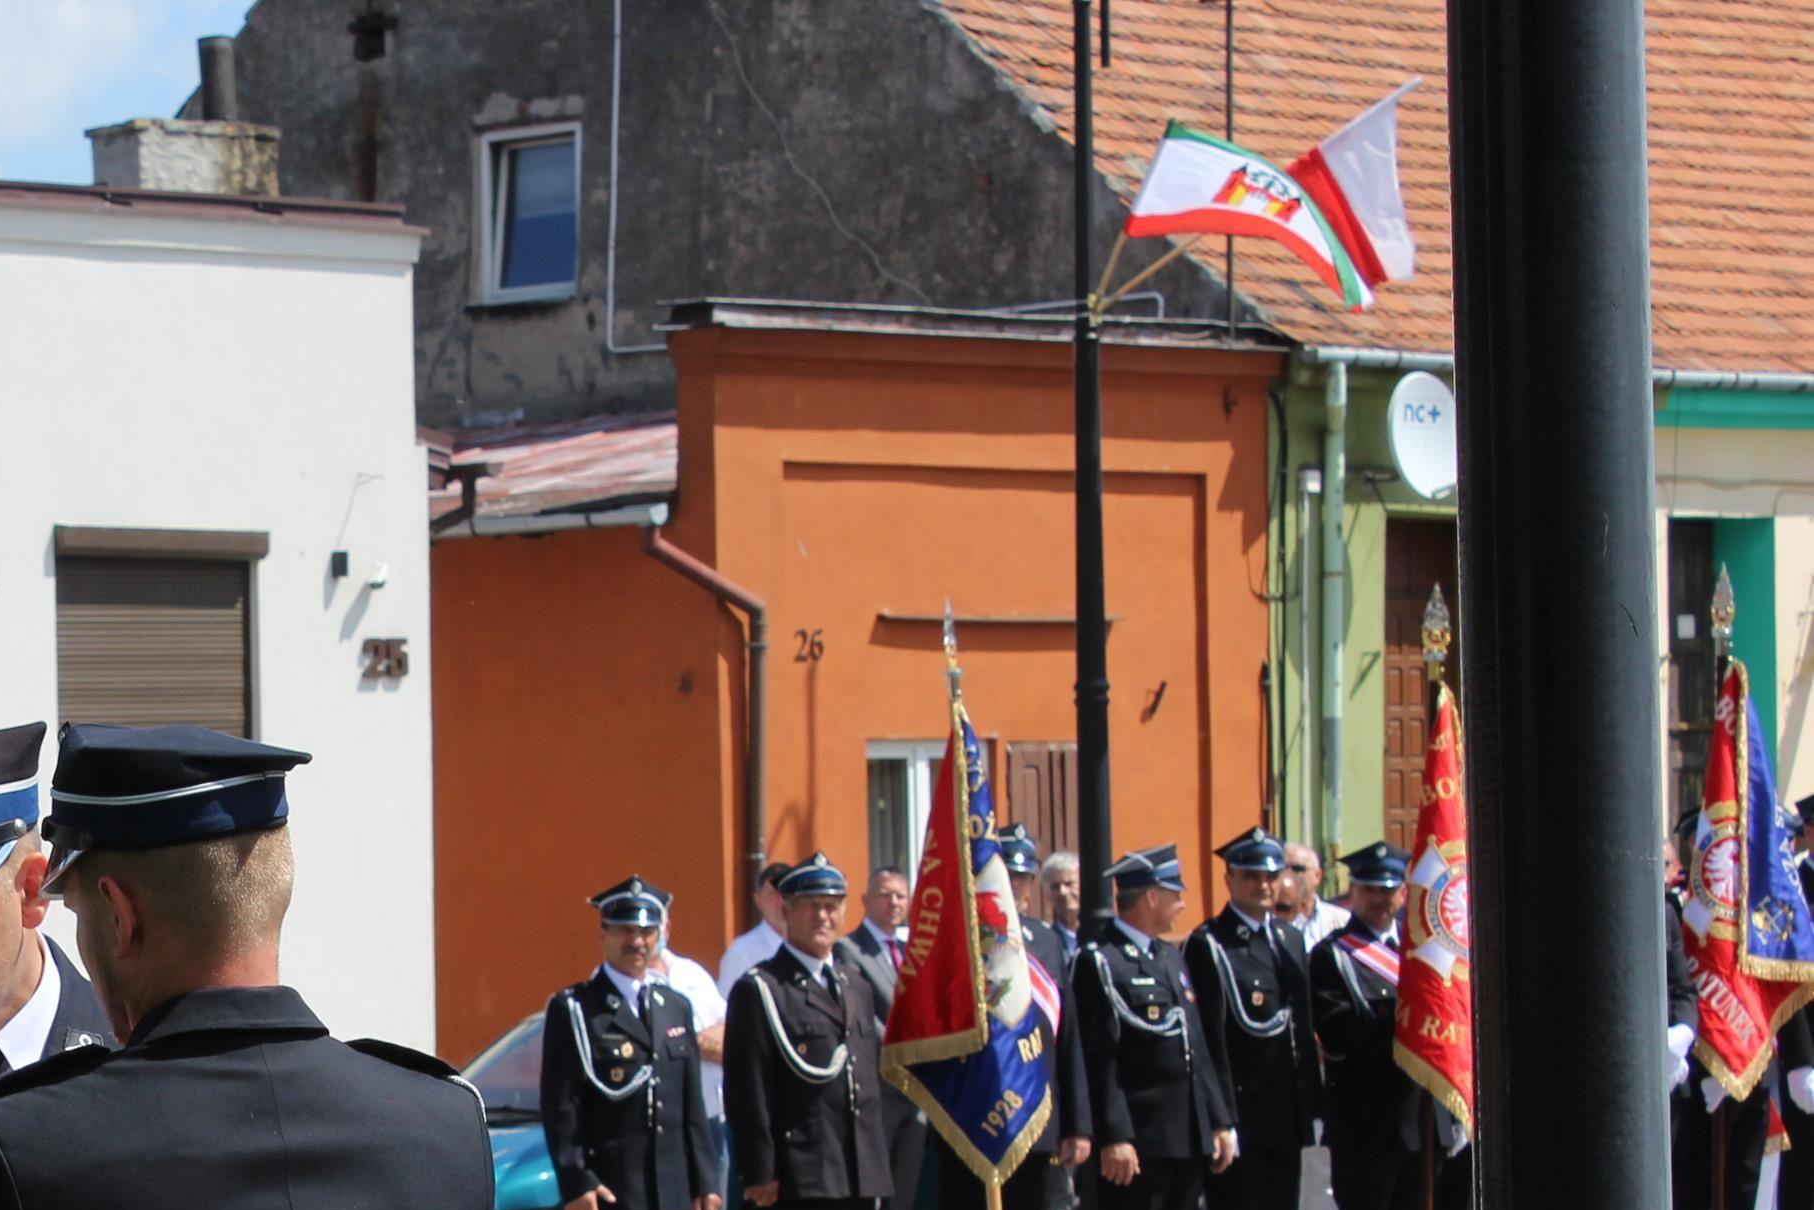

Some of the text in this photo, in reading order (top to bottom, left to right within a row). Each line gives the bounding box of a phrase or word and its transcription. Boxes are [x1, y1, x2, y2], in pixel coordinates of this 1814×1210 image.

[1404, 404, 1442, 425] nc+
[362, 638, 409, 678] 25
[794, 628, 824, 662] 26
[981, 1089, 1024, 1137] 1928
